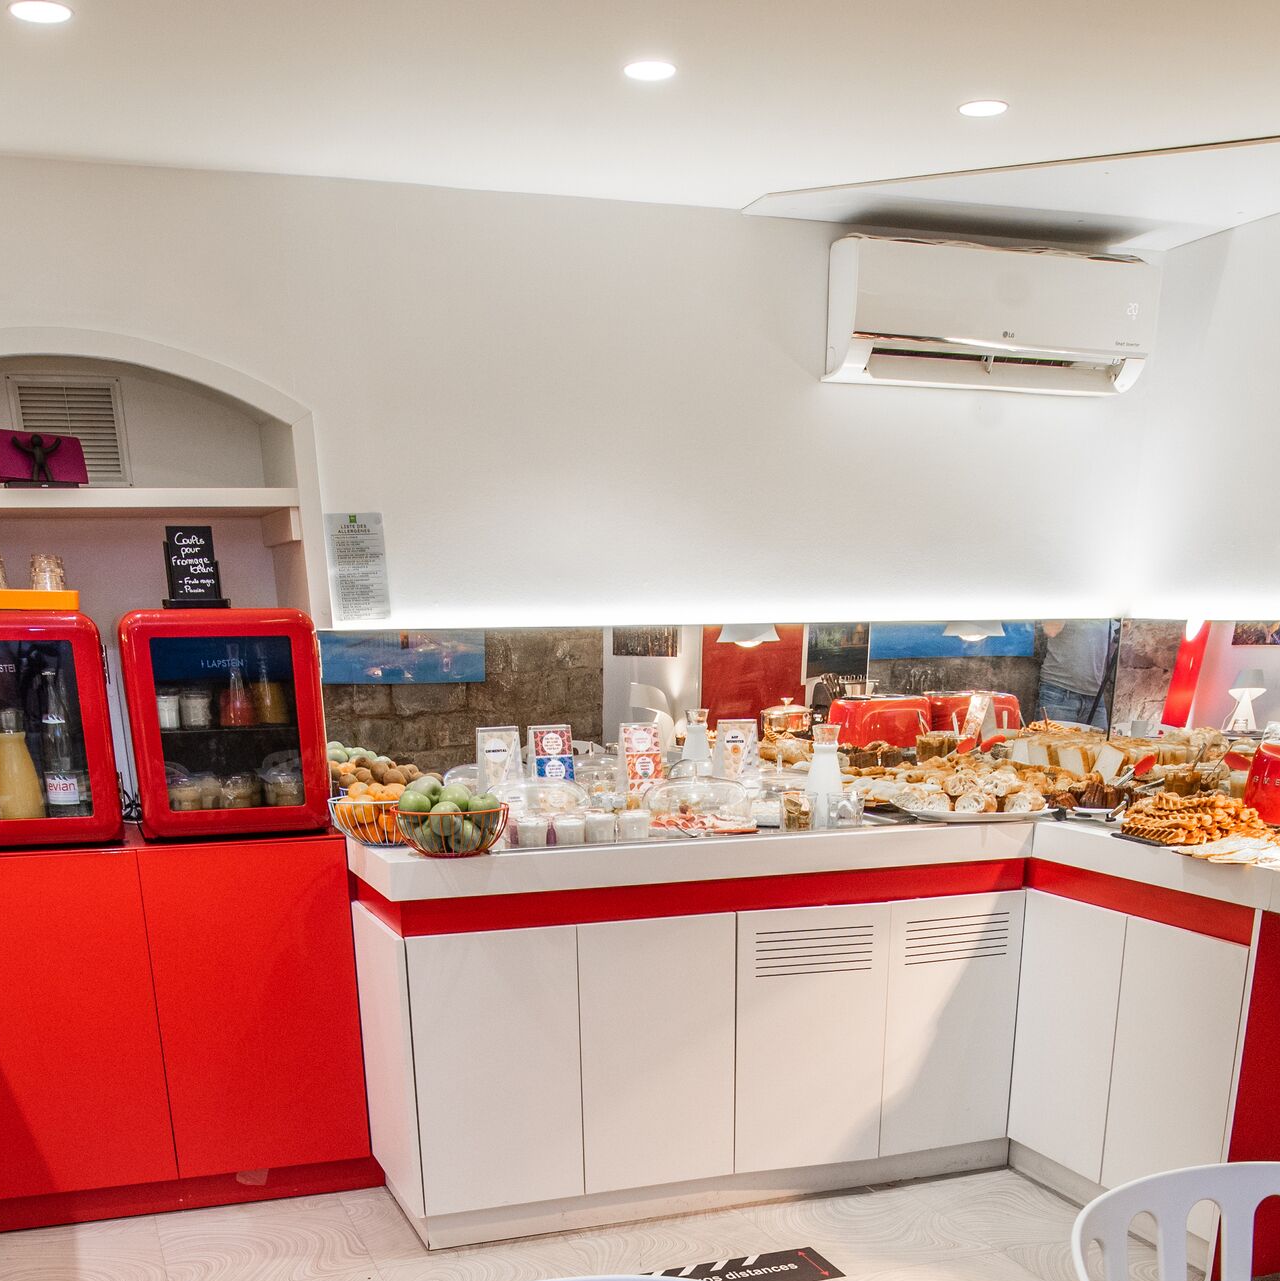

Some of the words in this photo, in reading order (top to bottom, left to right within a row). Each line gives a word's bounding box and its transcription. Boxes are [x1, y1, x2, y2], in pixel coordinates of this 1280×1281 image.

[181, 547, 200, 558] pour
[48, 782, 76, 791] evian
[725, 1263, 798, 1280] distances
